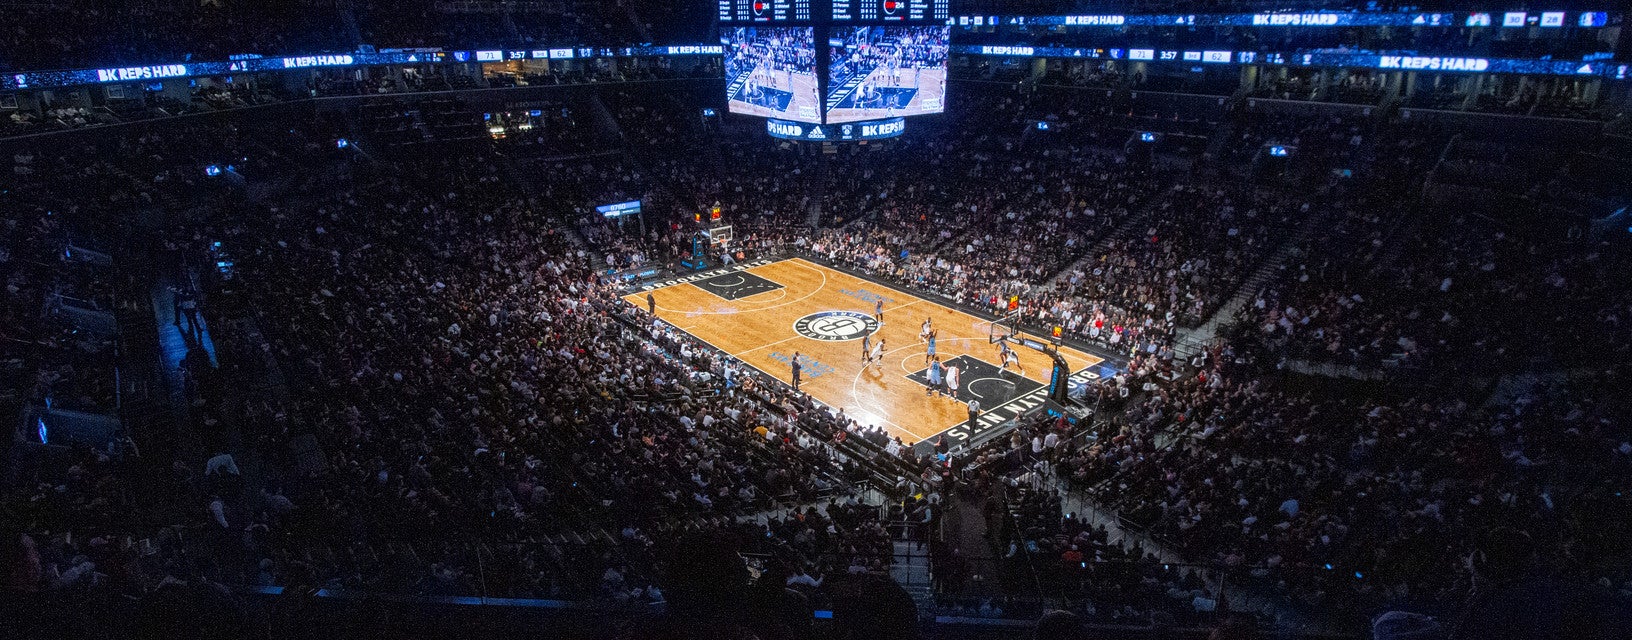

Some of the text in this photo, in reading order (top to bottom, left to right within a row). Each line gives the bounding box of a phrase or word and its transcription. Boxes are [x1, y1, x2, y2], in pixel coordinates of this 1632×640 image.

[1066, 15, 1124, 25] BK REPS HARD
[1253, 13, 1338, 25] BK REPS HARD
[509, 51, 526, 59] 3:57
[668, 46, 679, 54] BK
[680, 46, 700, 54] REPS
[982, 46, 1034, 56] BK REPS HARD
[1160, 51, 1177, 59] 3:57
[284, 55, 353, 68] BK REPS HARD
[1379, 56, 1488, 71] BK REPS HARD
[98, 64, 187, 81] BK REPS HARD
[777, 124, 802, 136] HARD
[862, 125, 877, 136] BK
[879, 122, 898, 135] REPS
[642, 259, 773, 291] BROOKLYN NETS
